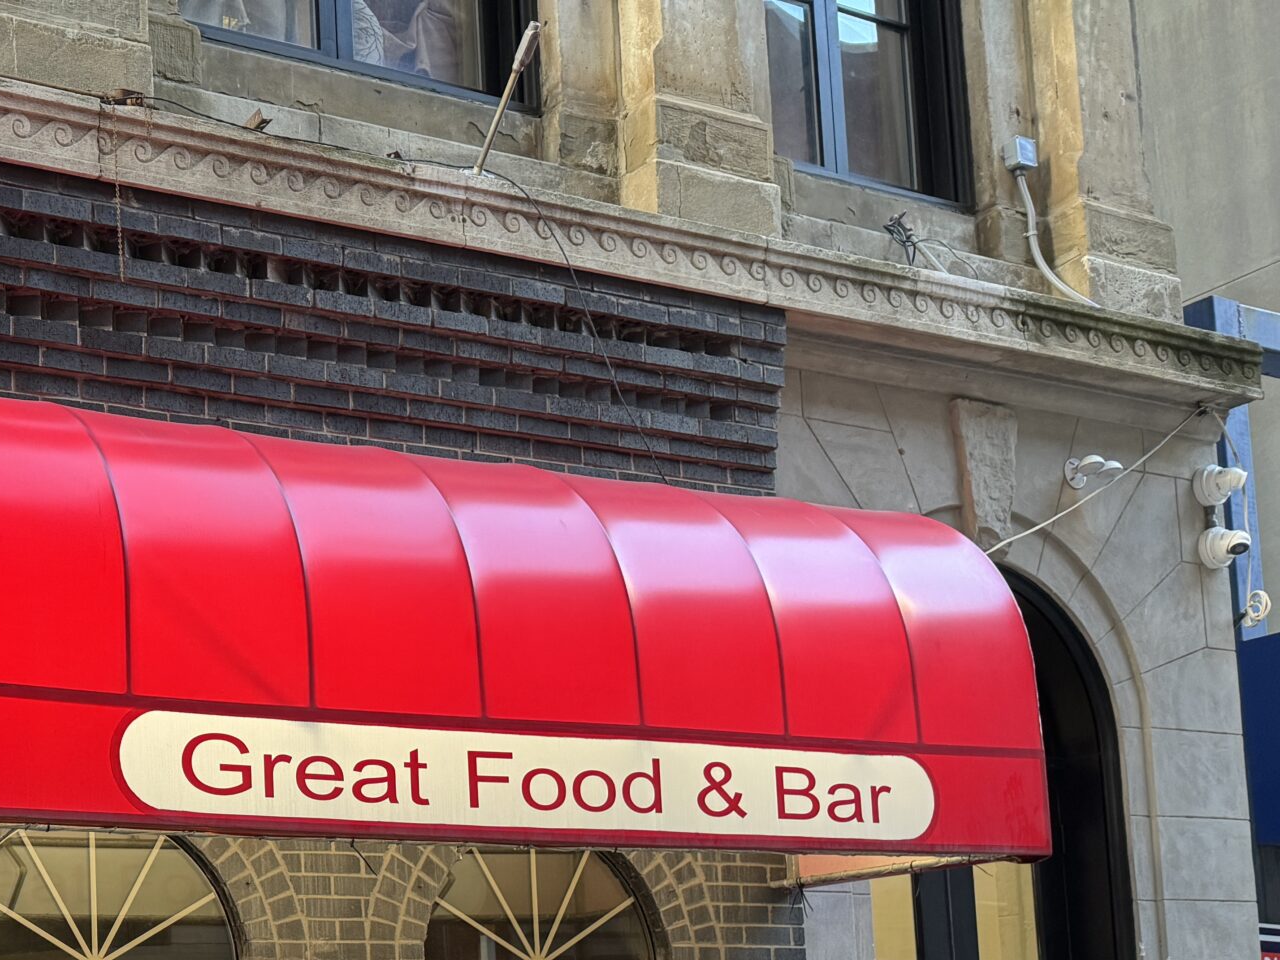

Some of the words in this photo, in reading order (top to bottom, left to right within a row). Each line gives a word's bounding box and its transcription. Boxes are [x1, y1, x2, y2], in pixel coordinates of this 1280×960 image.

[181, 732, 431, 807] Great
[467, 750, 663, 815] Food
[696, 761, 748, 818] &
[775, 765, 893, 825] Bar
